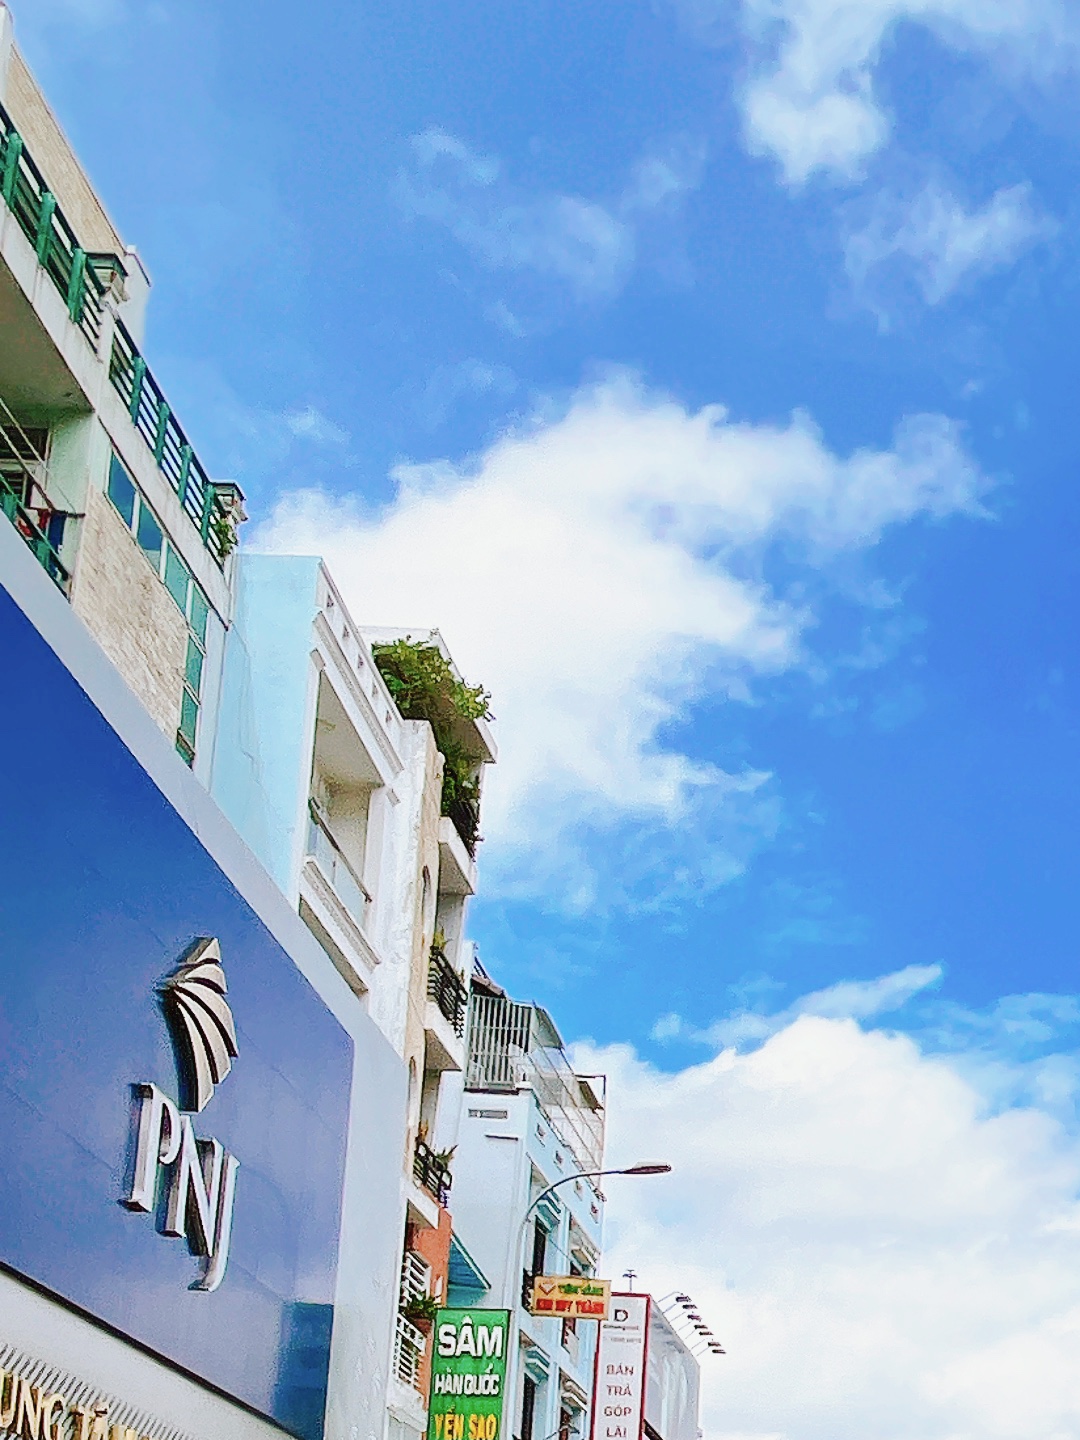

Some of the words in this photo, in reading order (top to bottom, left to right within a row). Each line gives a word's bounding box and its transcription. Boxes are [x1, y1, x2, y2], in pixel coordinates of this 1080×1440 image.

[119, 1082, 241, 1292] PNJ
[437, 1315, 503, 1358] SÂM
[606, 1362, 634, 1375] BÁN
[434, 1366, 463, 1396] HÀN
[606, 1383, 632, 1396] TRẢ
[604, 1404, 632, 1417] GÓP
